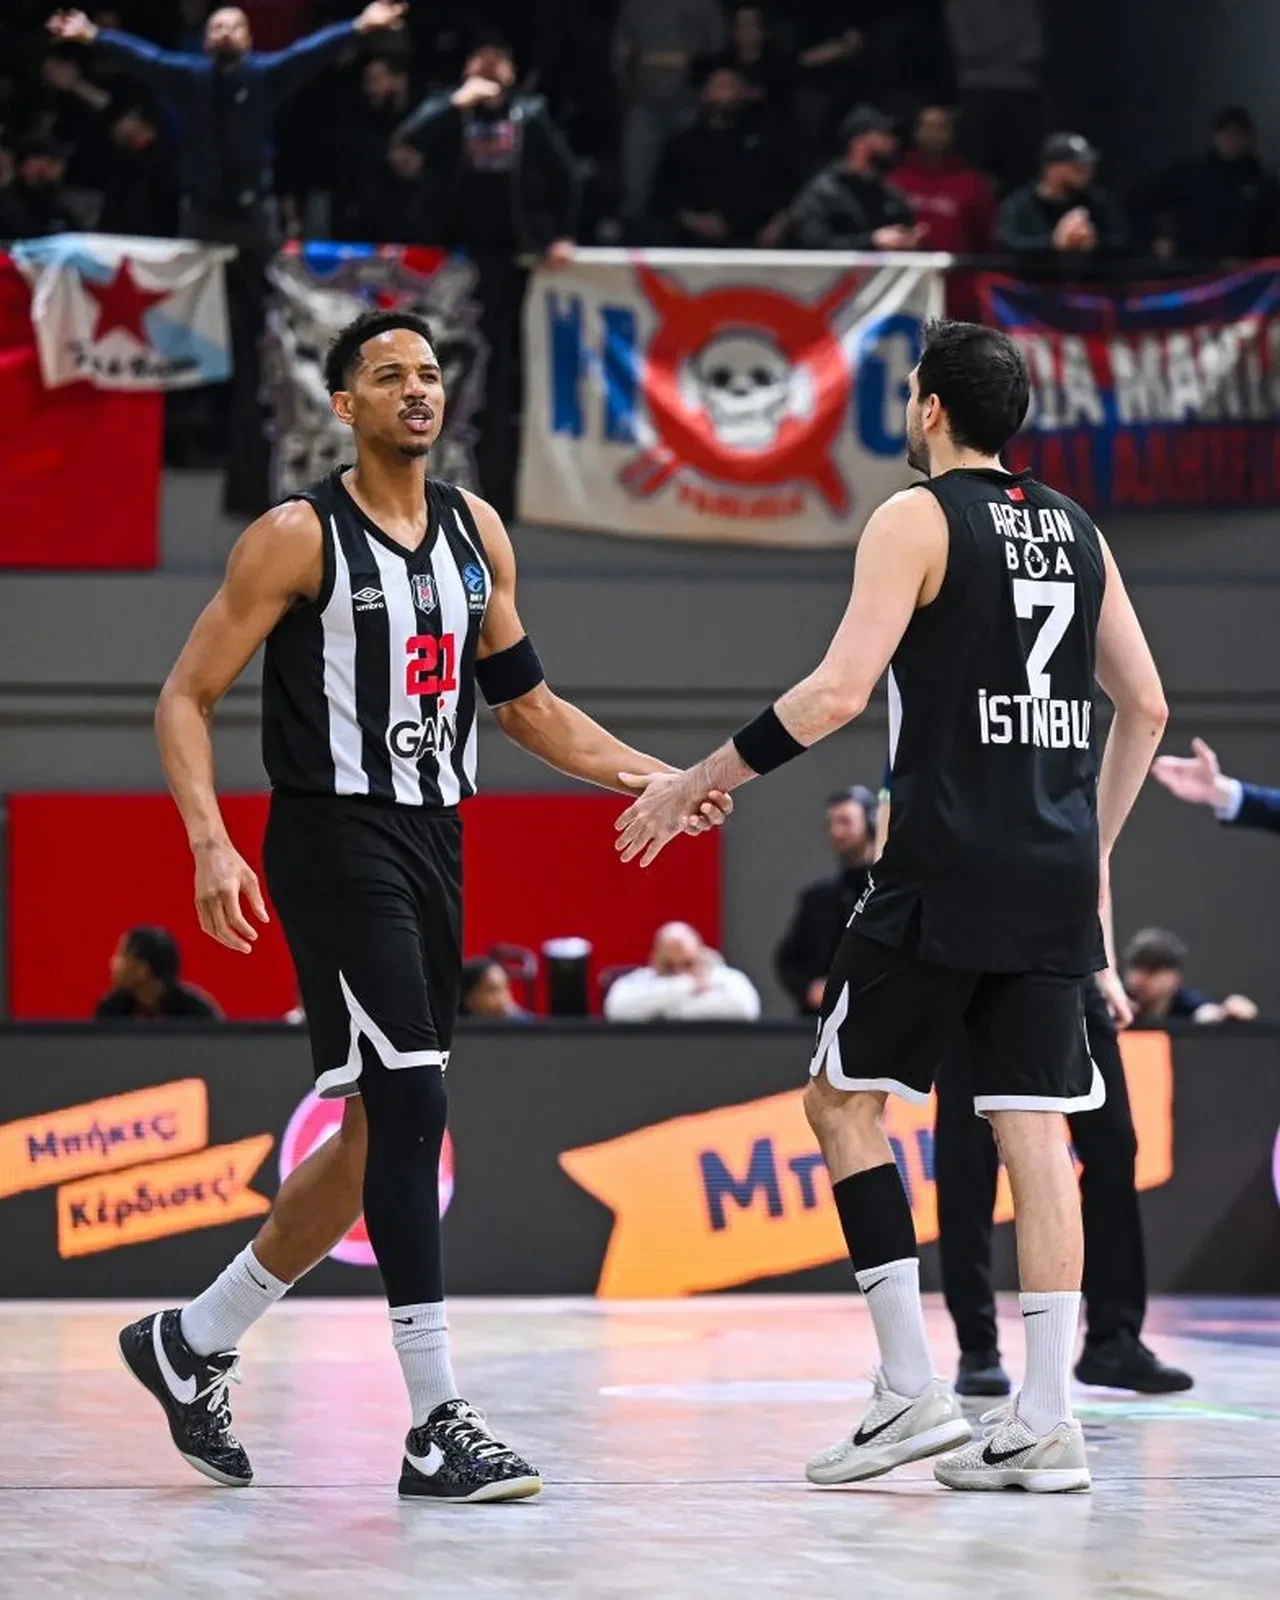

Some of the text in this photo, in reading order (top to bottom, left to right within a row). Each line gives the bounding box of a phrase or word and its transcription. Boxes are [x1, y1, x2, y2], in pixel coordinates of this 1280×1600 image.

[988, 502, 1075, 543] ARSLAN
[356, 602, 384, 612] umbro
[406, 633, 456, 695] 21
[1012, 578, 1075, 699] 7
